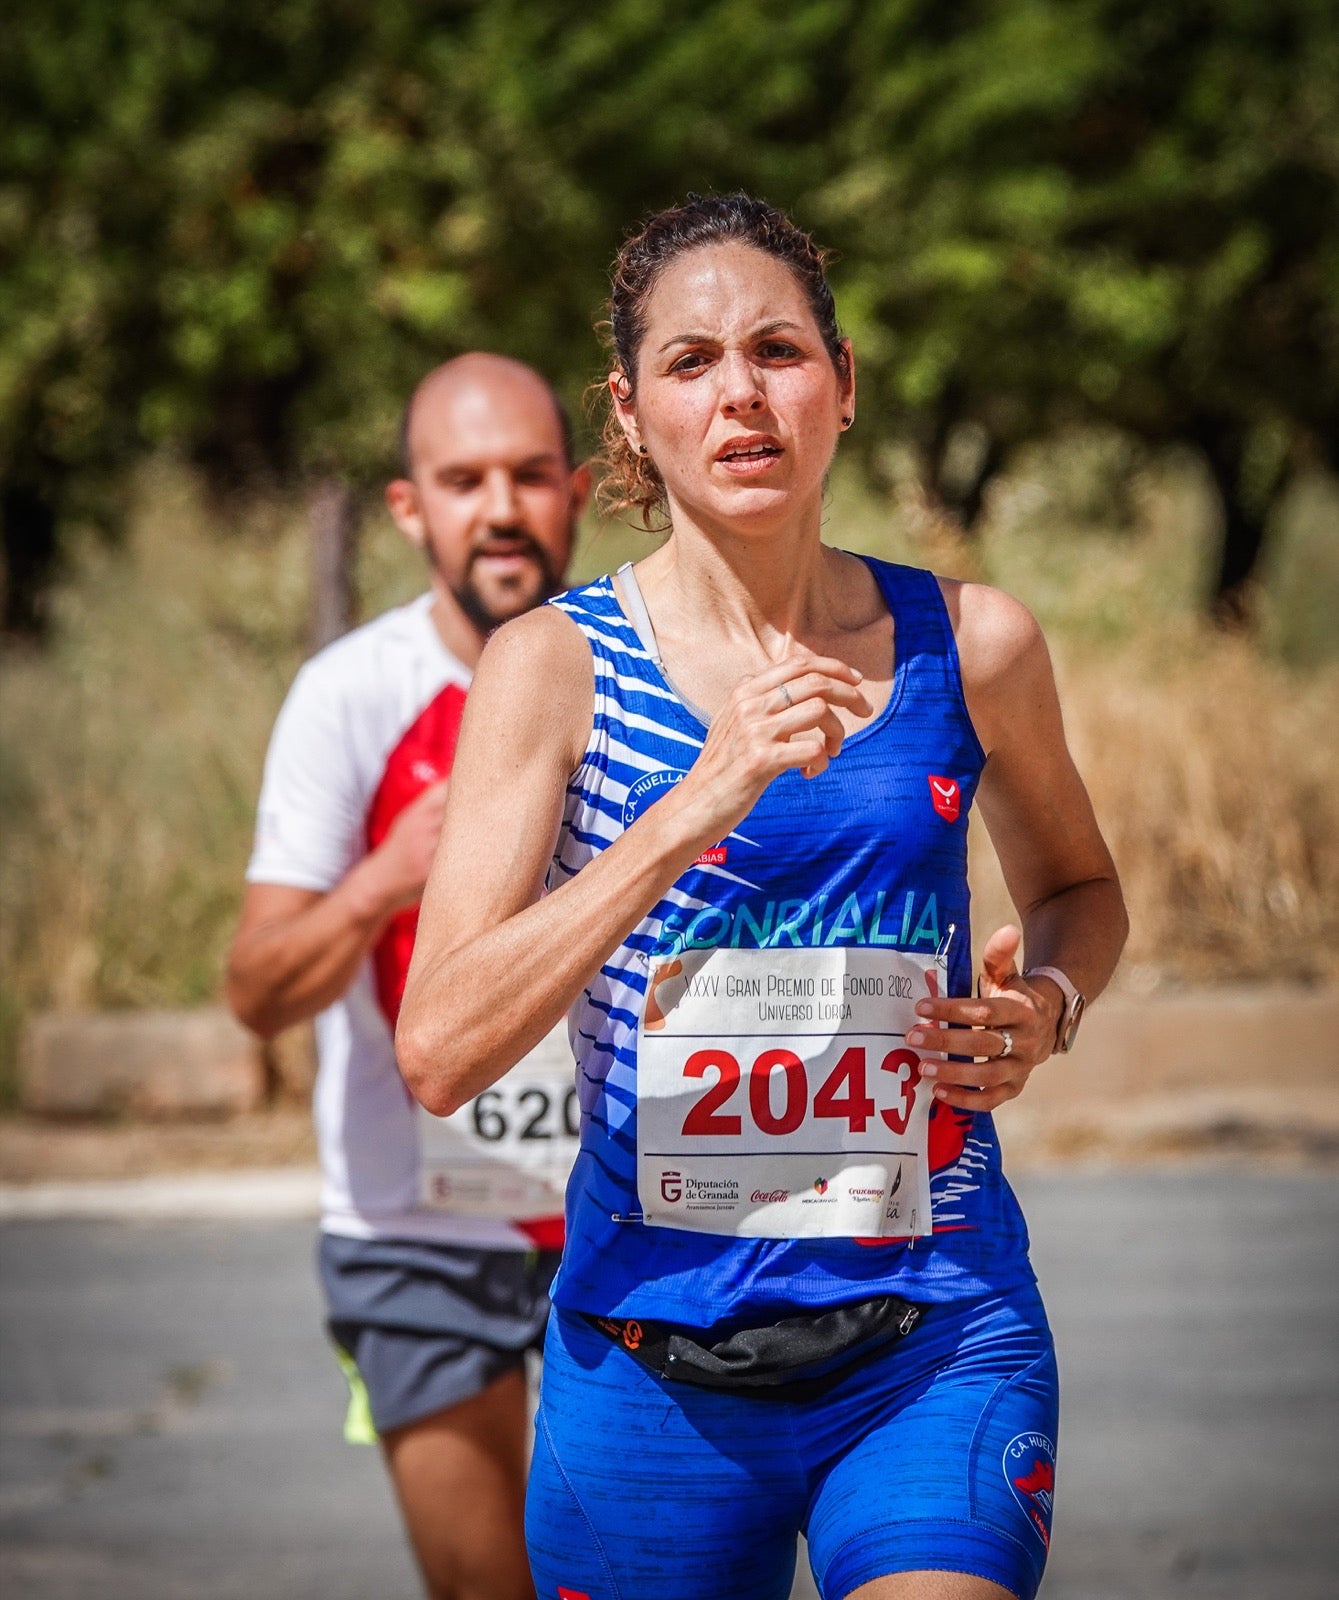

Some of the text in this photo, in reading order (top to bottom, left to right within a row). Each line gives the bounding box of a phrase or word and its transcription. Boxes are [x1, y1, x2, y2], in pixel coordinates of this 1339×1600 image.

[651, 890, 940, 957] SONRIALIA
[684, 975, 720, 998] XXXV
[888, 974, 914, 1000] 2022
[681, 1047, 922, 1136] 2043
[685, 1178, 739, 1190] Diputación
[848, 1187, 885, 1197] Cruzcampo
[685, 1190, 740, 1200] de Granada
